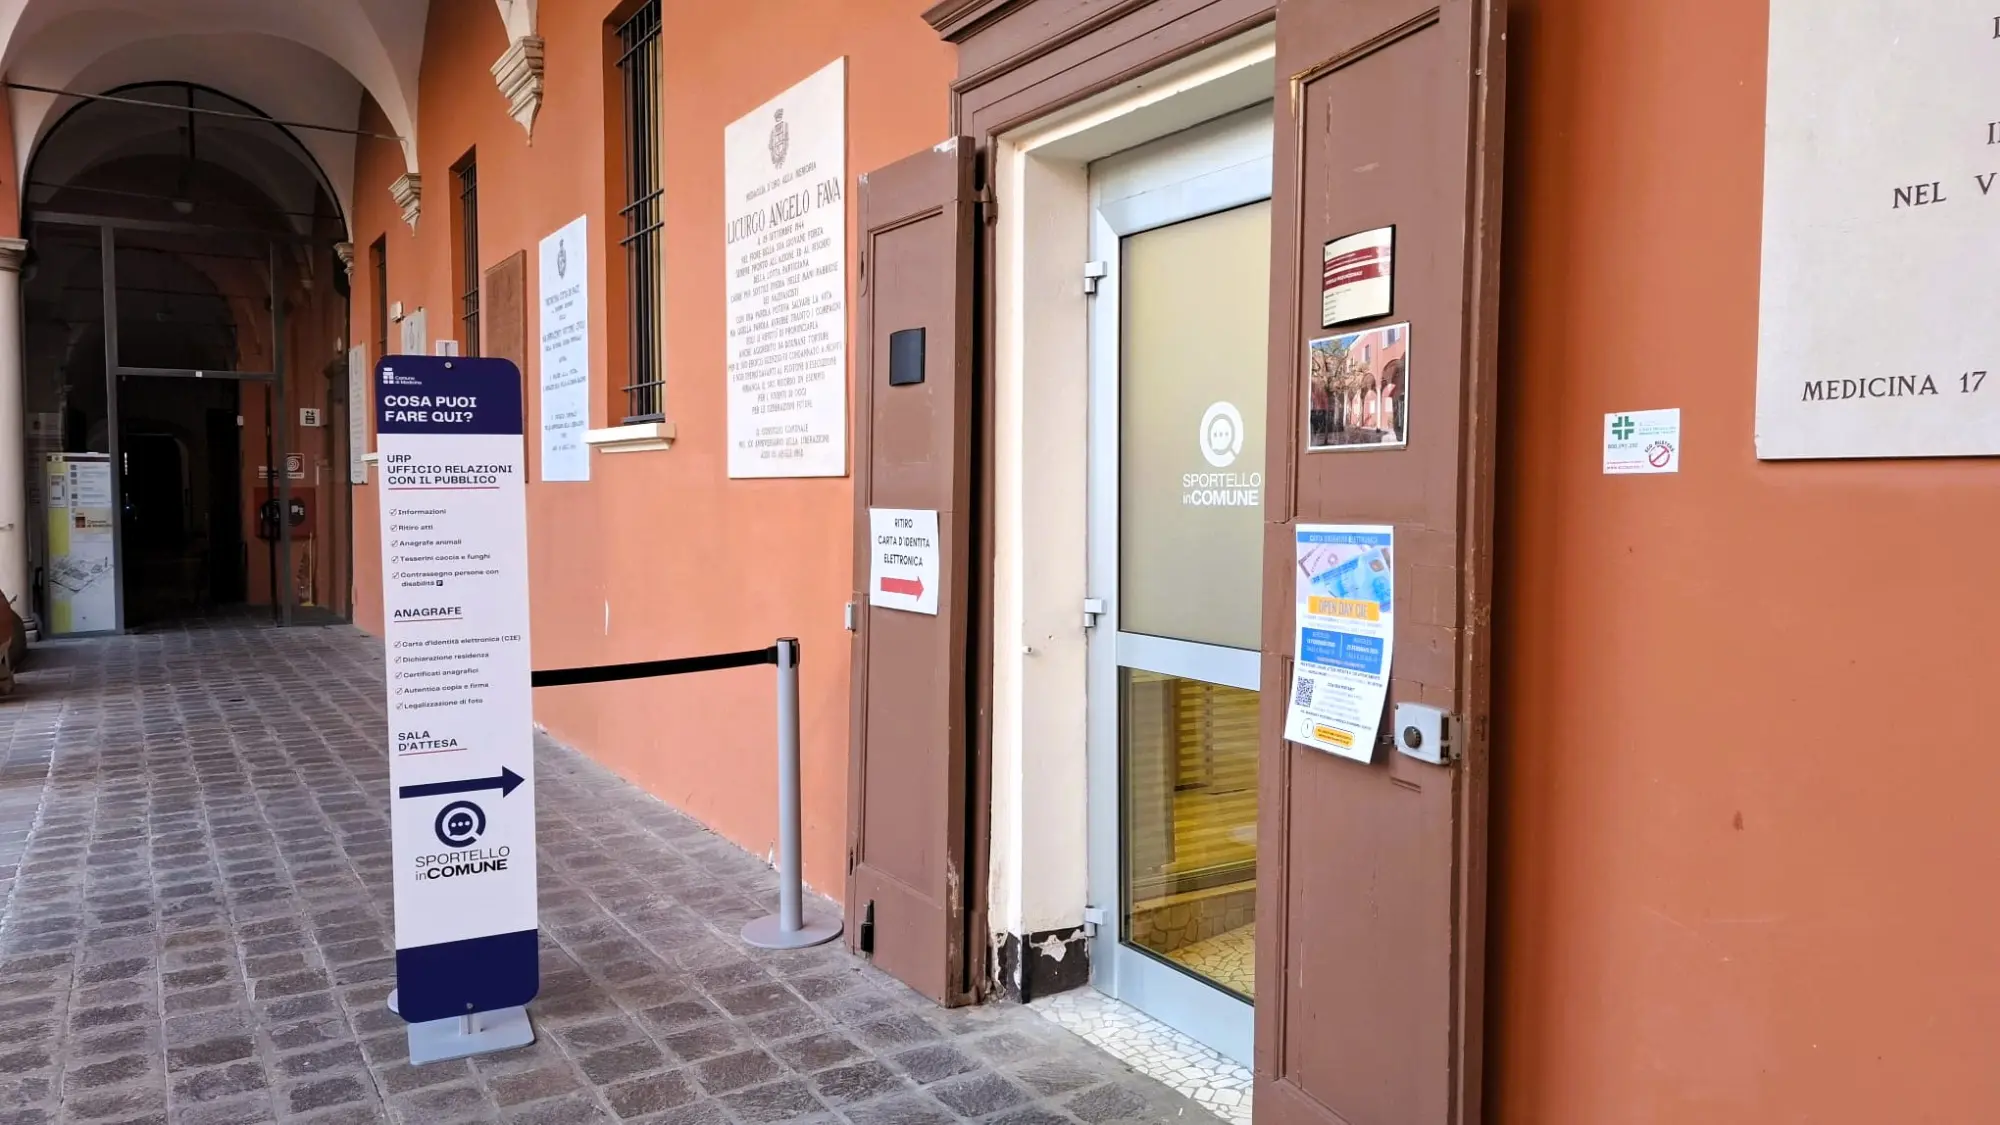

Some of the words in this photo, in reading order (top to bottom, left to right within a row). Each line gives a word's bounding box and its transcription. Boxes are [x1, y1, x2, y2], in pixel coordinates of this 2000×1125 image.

[1892, 181, 1947, 209] NEL
[728, 209, 765, 244] LICURGO
[769, 188, 810, 228] ANGELO
[817, 176, 841, 208] FAVA
[1802, 374, 1938, 402] MEDICINA
[1959, 370, 1987, 394] 17
[384, 395, 432, 407] COSA
[435, 396, 477, 408] PUOI
[385, 411, 428, 422] FARE
[431, 411, 473, 422] QUI?
[387, 454, 411, 463] URP
[387, 465, 442, 474] UFFICIO
[445, 465, 512, 473] RELAZIONI
[388, 476, 416, 485] CON
[419, 476, 432, 484] IL
[434, 475, 497, 484] PUBBLICO
[1183, 472, 1261, 487] SPORTELLO
[1183, 490, 1259, 506] inCOMUNE
[895, 518, 913, 528] RITIRO
[878, 535, 897, 546] CARTA
[884, 553, 923, 567] ELETTRONICA
[394, 606, 462, 619] ANAGRAFE
[1319, 599, 1337, 615] OPEN
[1339, 602, 1353, 617] DAY
[402, 654, 453, 663] Dichiarazione
[442, 668, 479, 676] anagrafici
[404, 700, 458, 710] Legalizzazione
[398, 730, 430, 741] SALA
[398, 738, 458, 752] D'ATTESA
[415, 846, 510, 868] SPORTELLO
[415, 858, 508, 881] inCOMUNE
